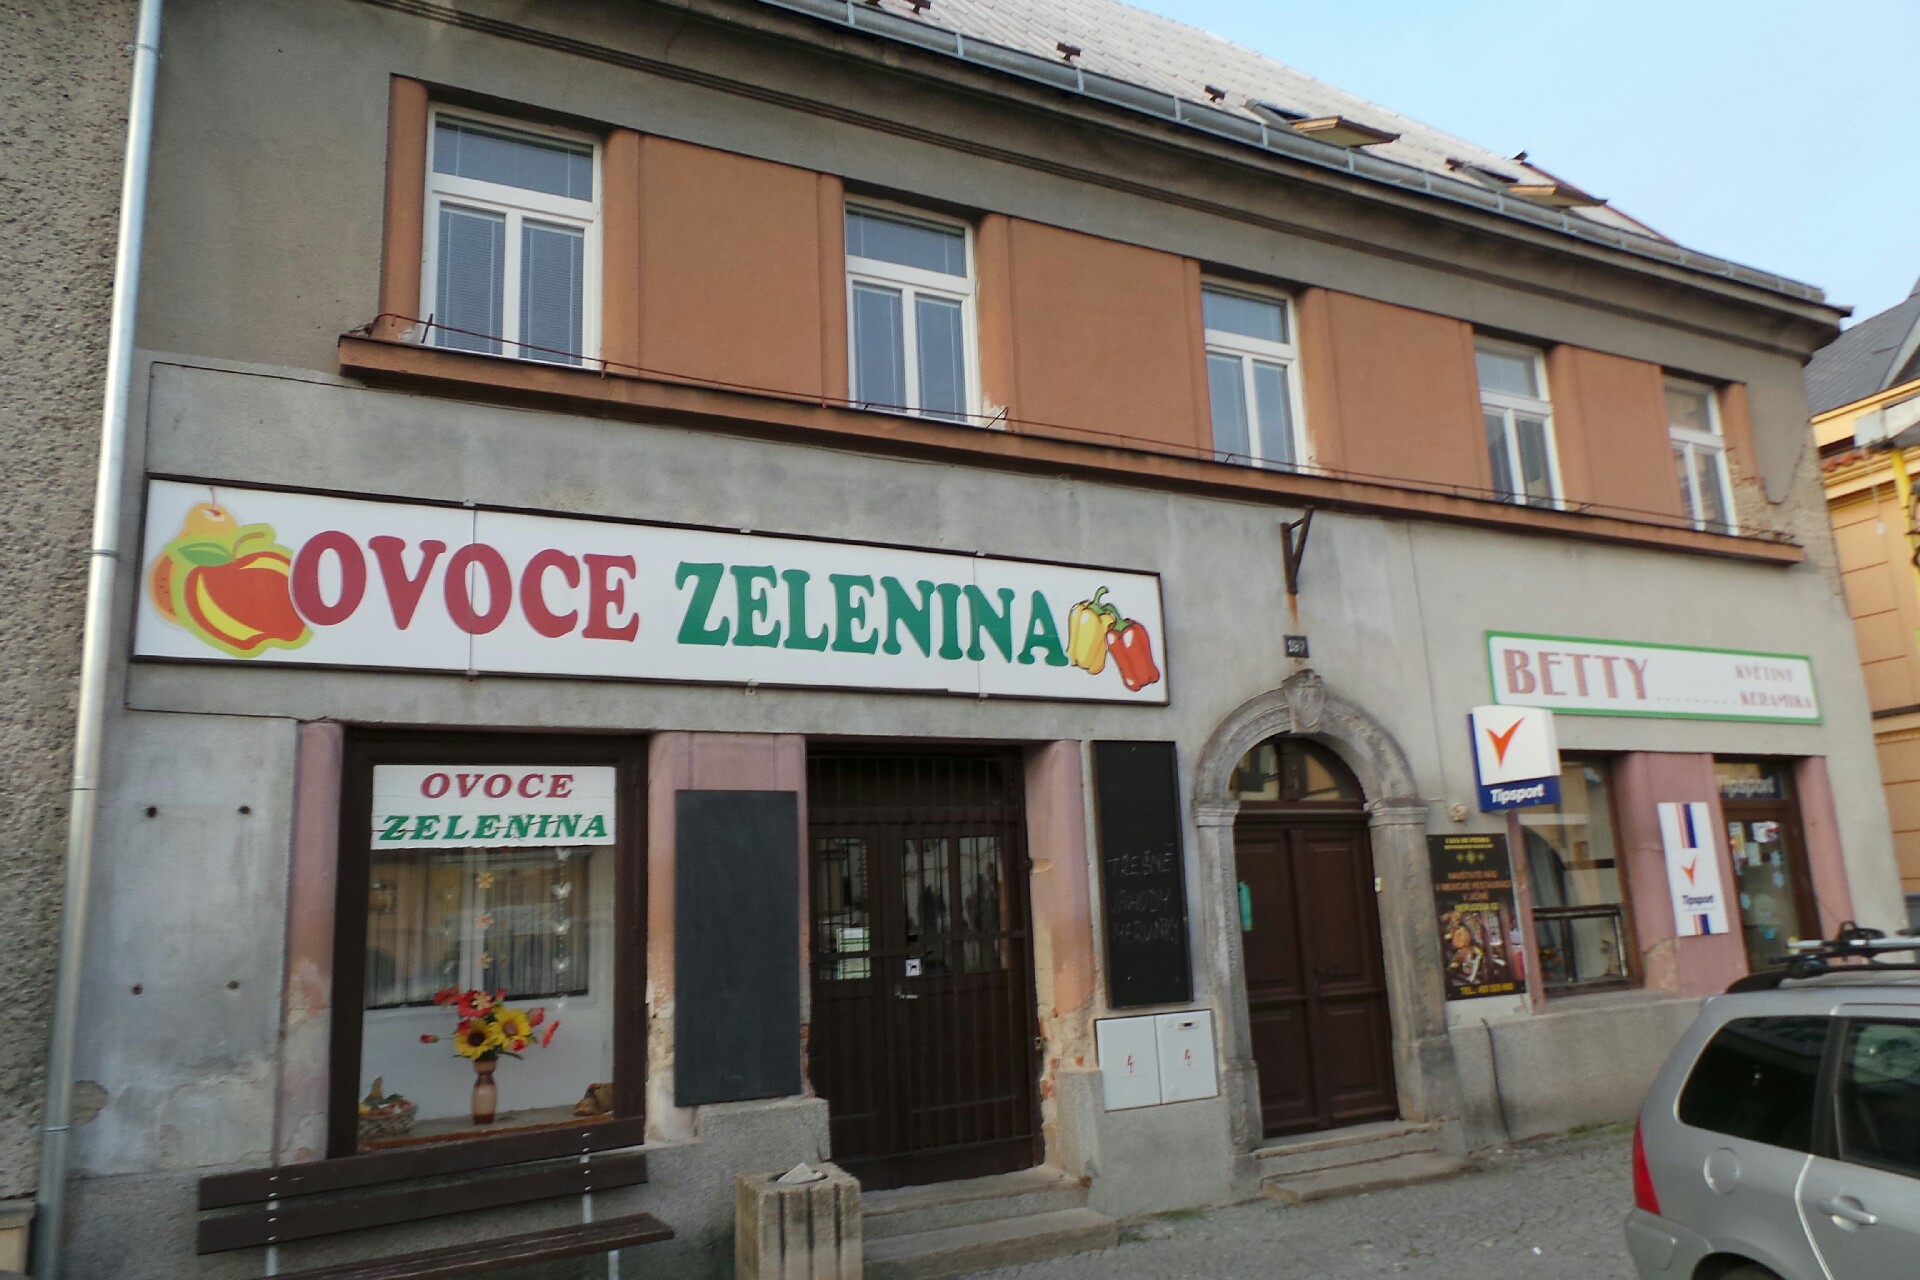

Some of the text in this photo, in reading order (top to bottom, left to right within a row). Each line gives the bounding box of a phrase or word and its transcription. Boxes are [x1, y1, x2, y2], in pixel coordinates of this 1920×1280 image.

[292, 530, 1069, 667] OVOCE ZELENINA
[1503, 649, 1648, 700] BETTY
[420, 772, 574, 799] OVOCE
[1490, 784, 1546, 804] Tipsport
[379, 814, 607, 841] ZELENINA
